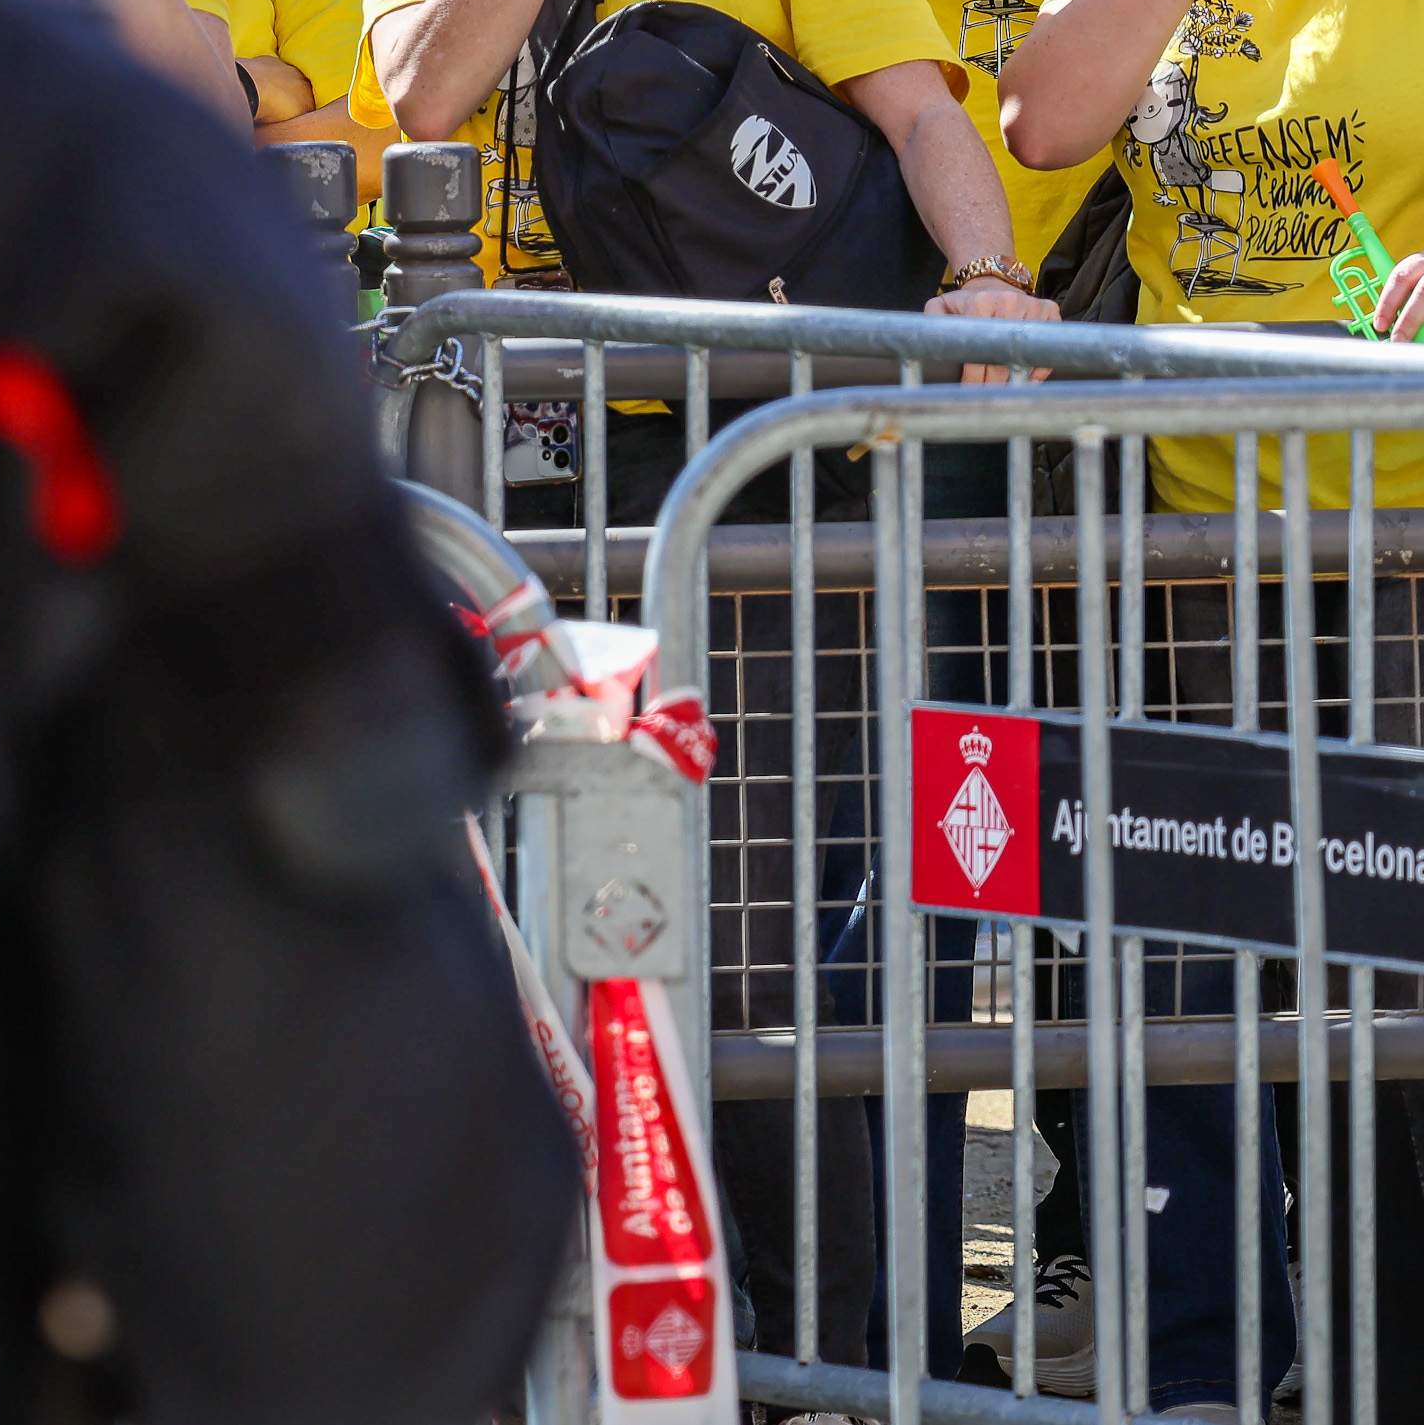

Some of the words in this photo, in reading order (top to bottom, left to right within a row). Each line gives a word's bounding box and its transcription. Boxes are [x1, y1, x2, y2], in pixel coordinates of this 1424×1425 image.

[1200, 115, 1354, 171] DEFENSEM
[1051, 798, 1228, 860] Ajntament
[1231, 816, 1268, 864] de
